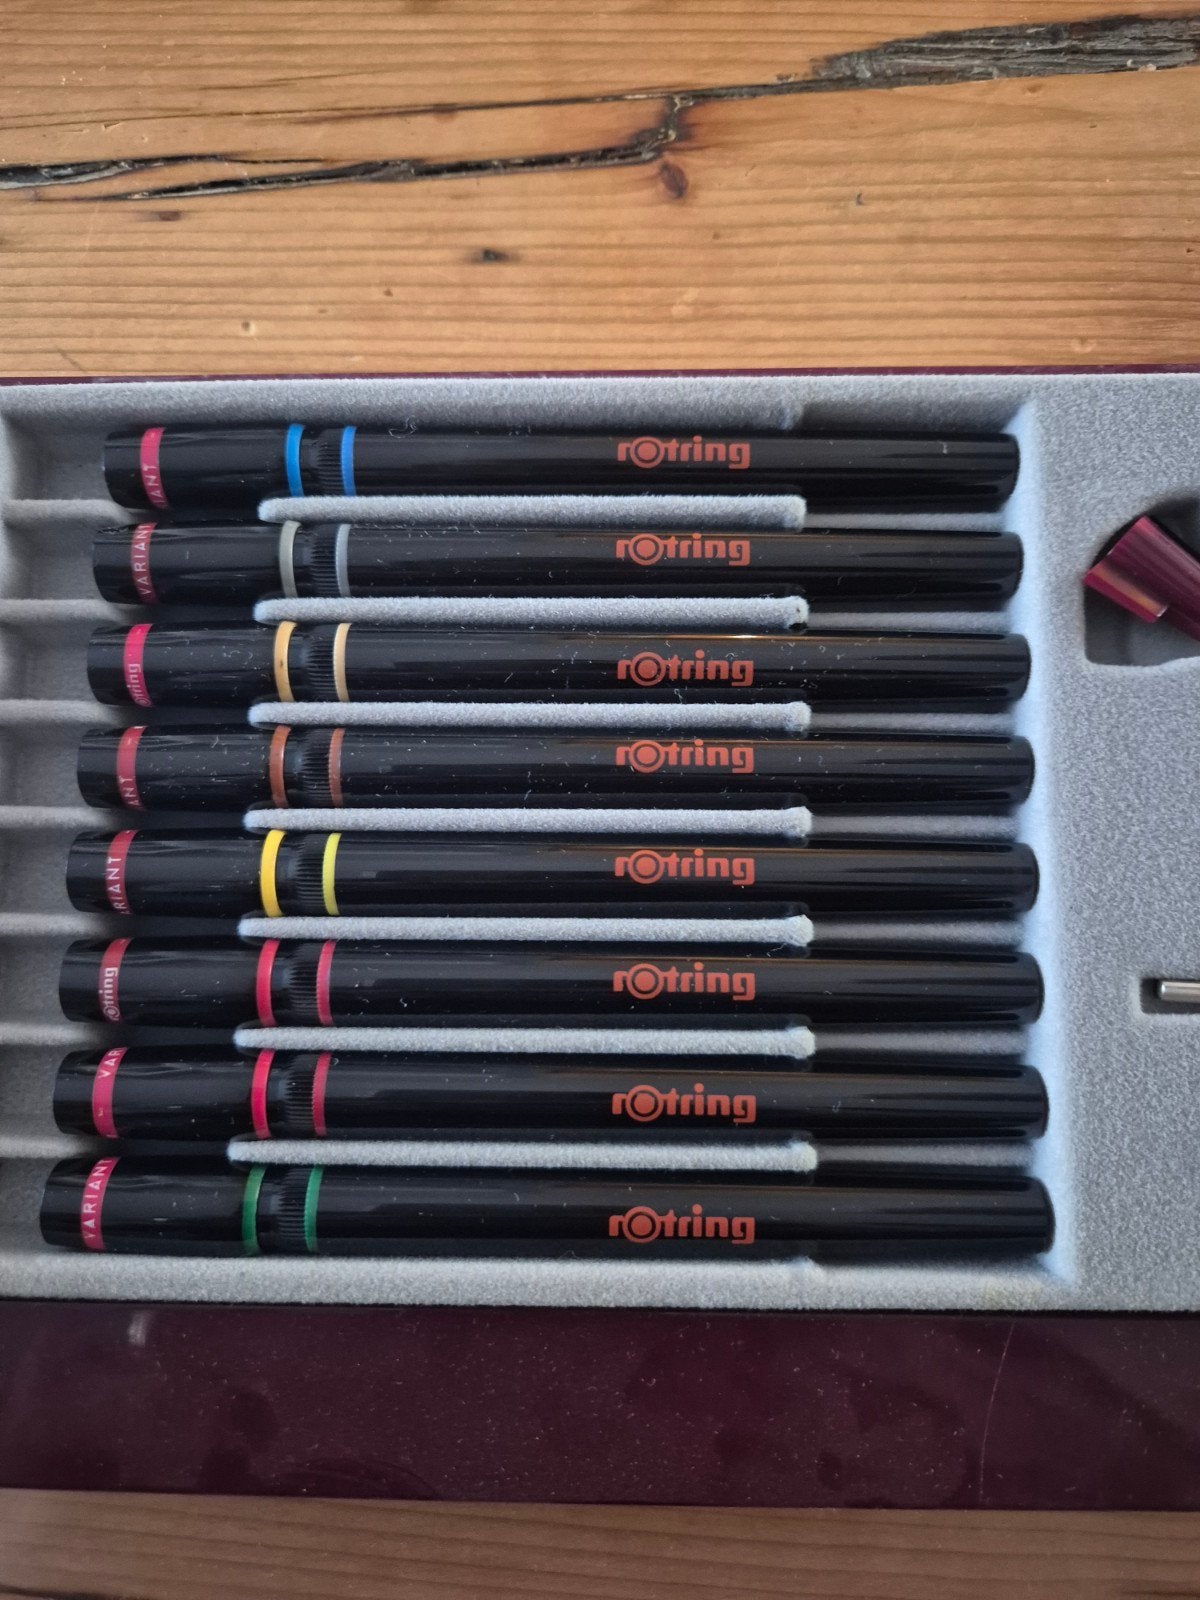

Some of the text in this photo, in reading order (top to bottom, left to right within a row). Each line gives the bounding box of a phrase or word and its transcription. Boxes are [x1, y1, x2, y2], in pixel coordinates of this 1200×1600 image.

[617, 436, 750, 469] rotring
[615, 533, 750, 566] rotring
[617, 650, 754, 686] rotring
[615, 739, 754, 774] rotring
[614, 848, 755, 885] rotring
[612, 962, 755, 1001] rotring
[612, 1083, 756, 1123] rotring
[608, 1204, 755, 1244] rotring
